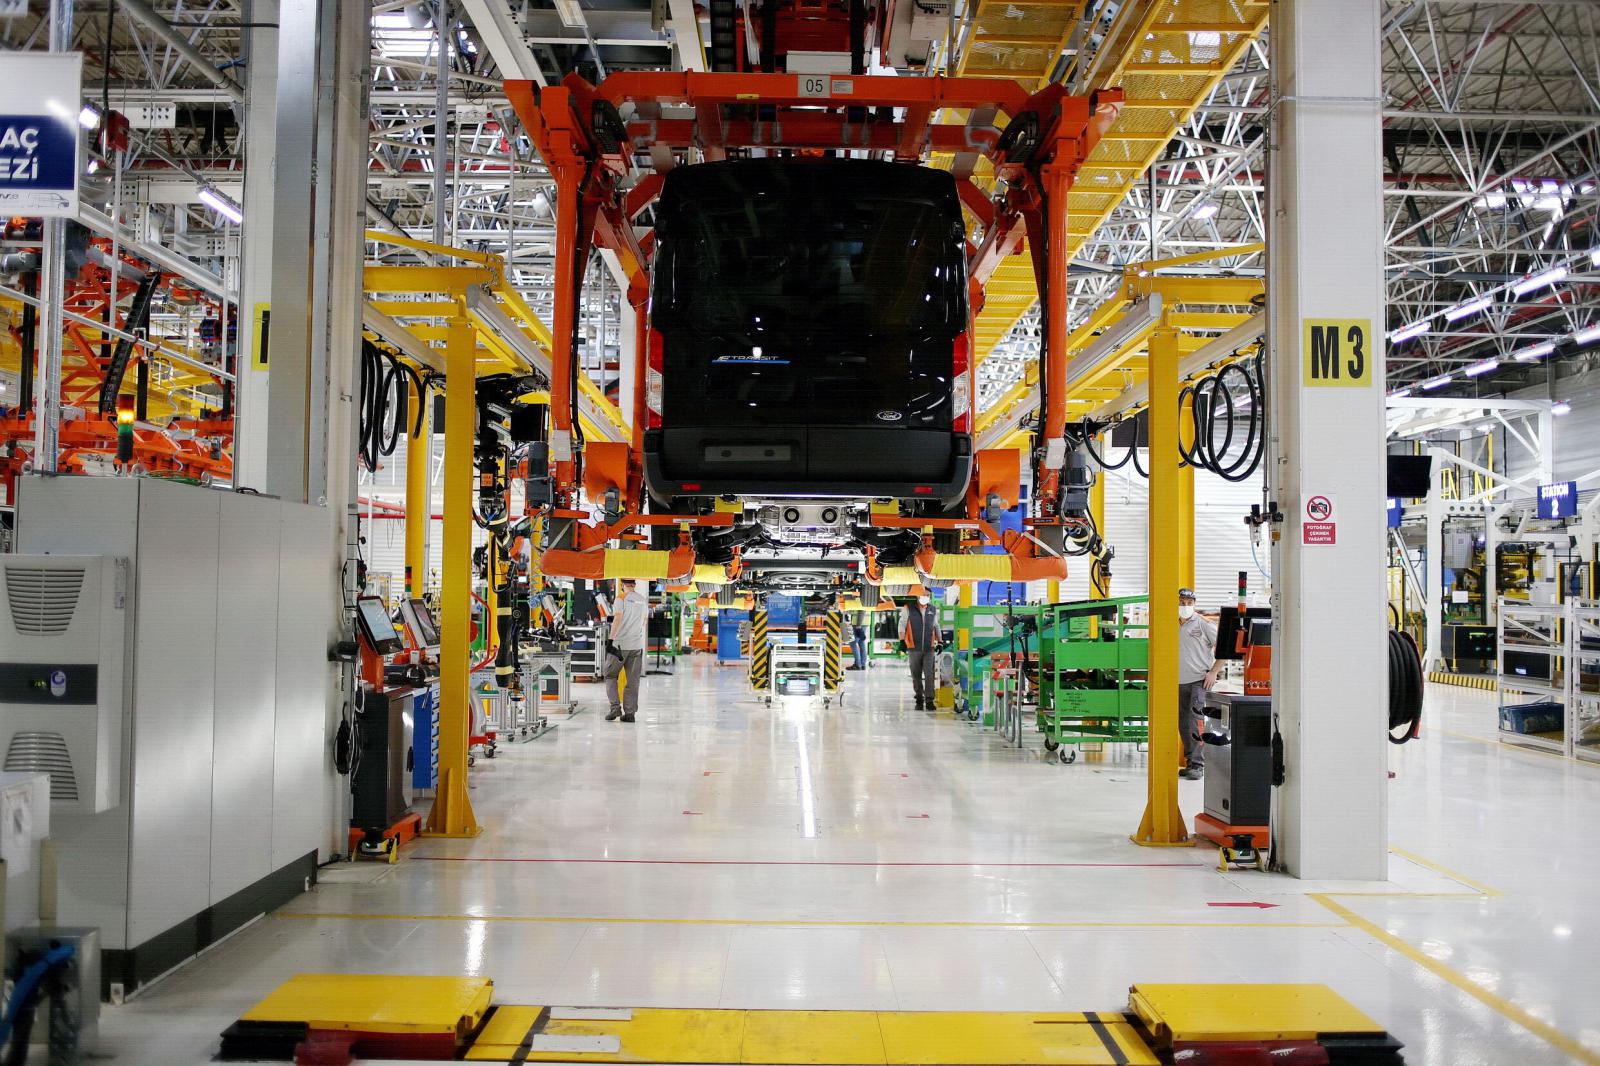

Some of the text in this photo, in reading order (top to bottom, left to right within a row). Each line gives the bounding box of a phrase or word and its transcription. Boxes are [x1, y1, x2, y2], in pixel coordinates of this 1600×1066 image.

[806, 79, 823, 92] 05
[1541, 484, 1569, 498] STATION
[1551, 499, 1559, 516] 2
